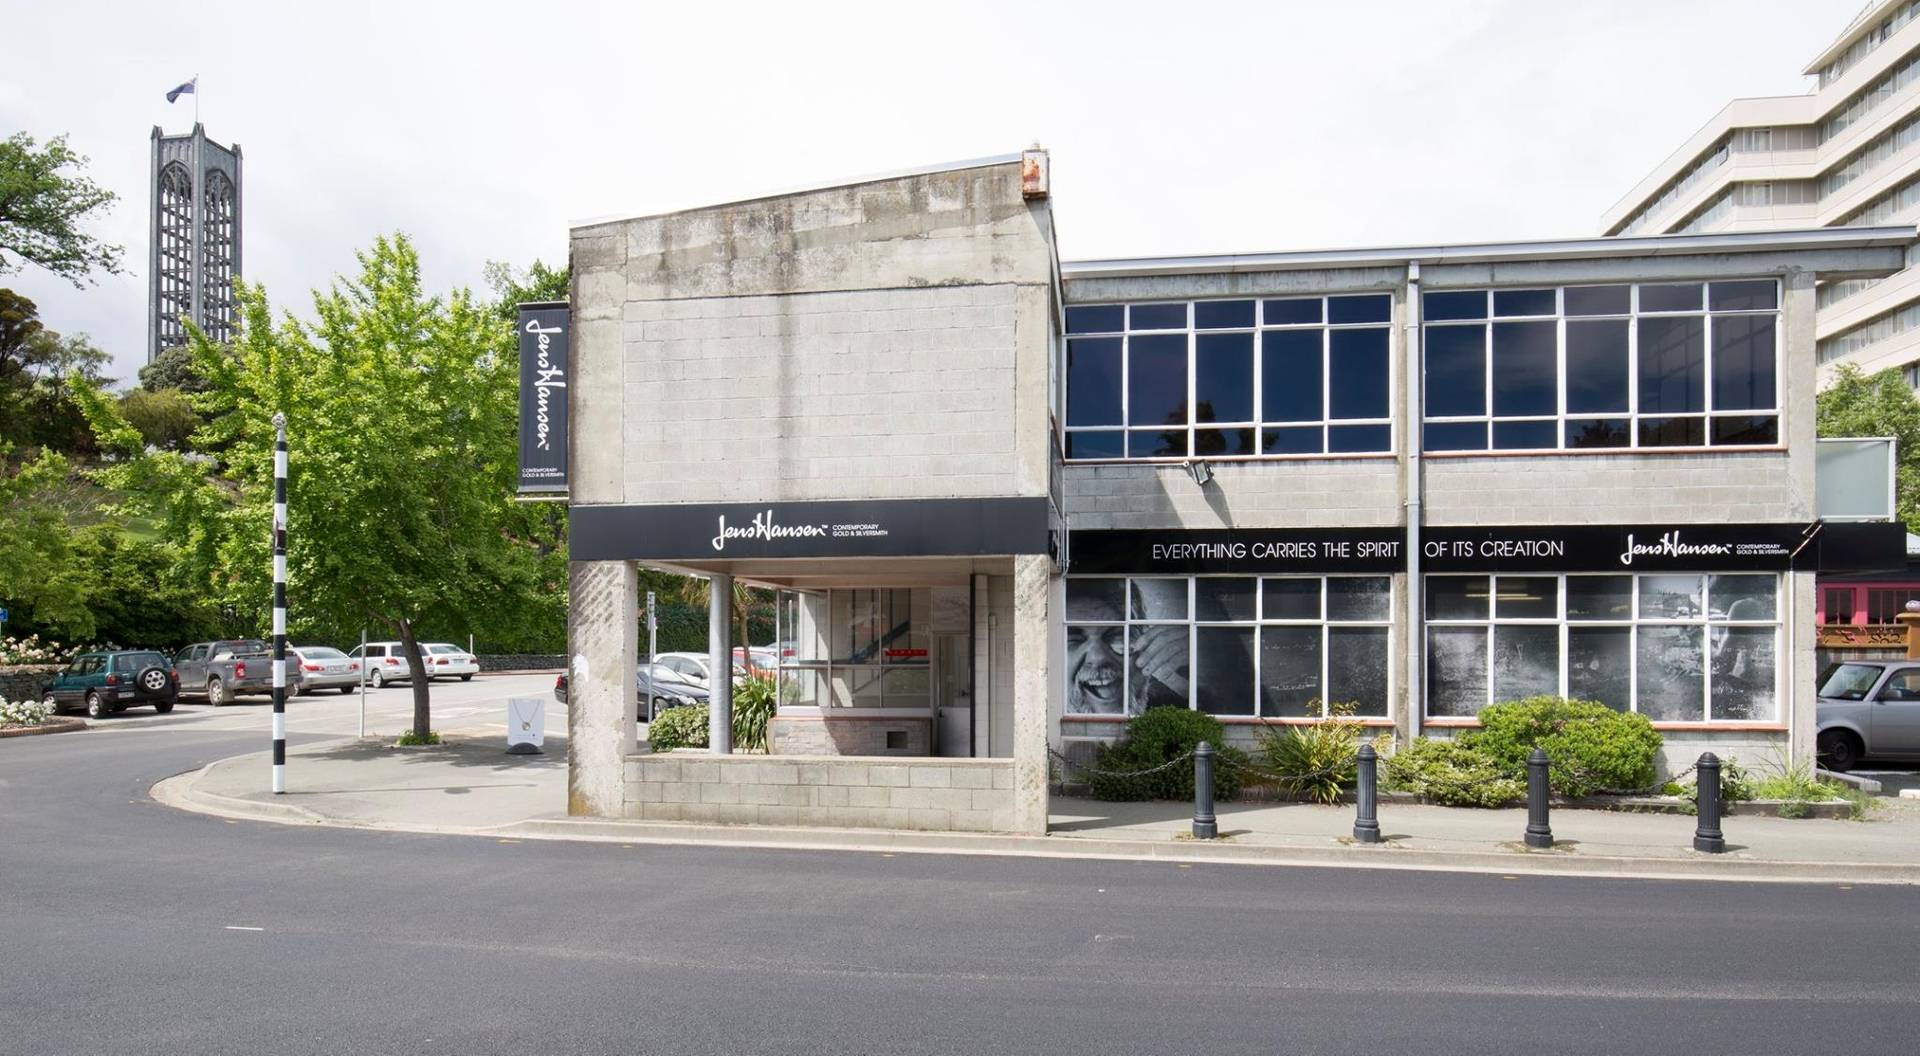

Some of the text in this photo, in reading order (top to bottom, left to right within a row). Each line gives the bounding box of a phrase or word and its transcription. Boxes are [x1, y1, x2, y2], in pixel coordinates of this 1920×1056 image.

[1152, 540, 1564, 560] EVERYTHING CARRIES THE SPIRIT OF ITS CREATION
